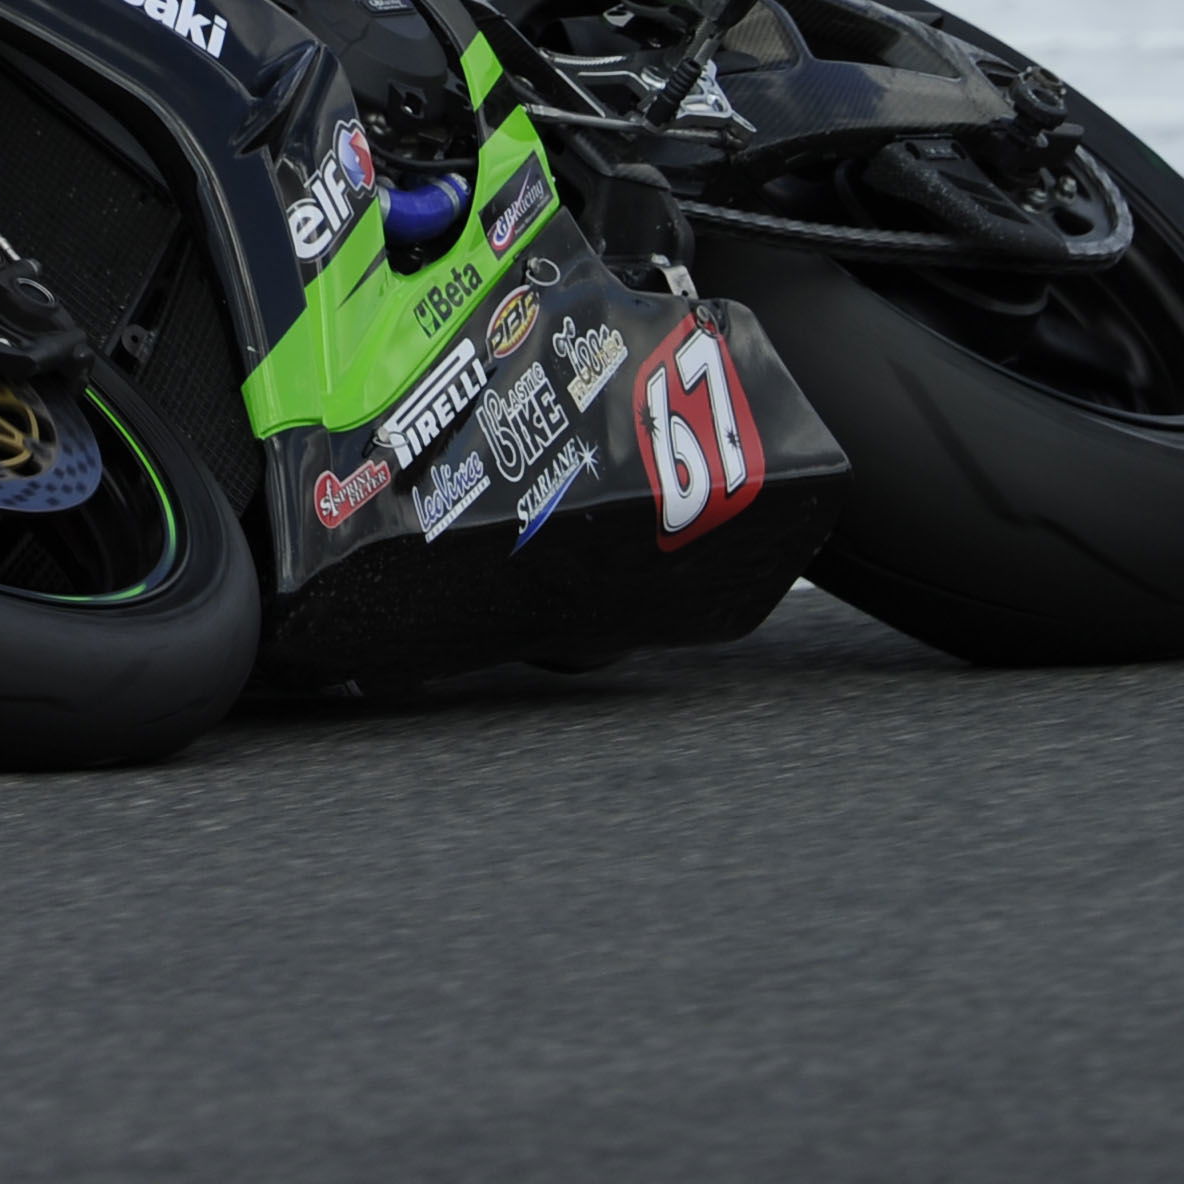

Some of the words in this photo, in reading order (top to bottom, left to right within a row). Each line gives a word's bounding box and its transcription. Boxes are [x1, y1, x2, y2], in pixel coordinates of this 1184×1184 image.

[290, 156, 352, 260] elf
[433, 261, 483, 327] Beta
[387, 338, 488, 470] PIRELLI
[645, 329, 750, 533] 67
[412, 451, 484, 533] LeoVince
[517, 438, 579, 534] STARLANE
